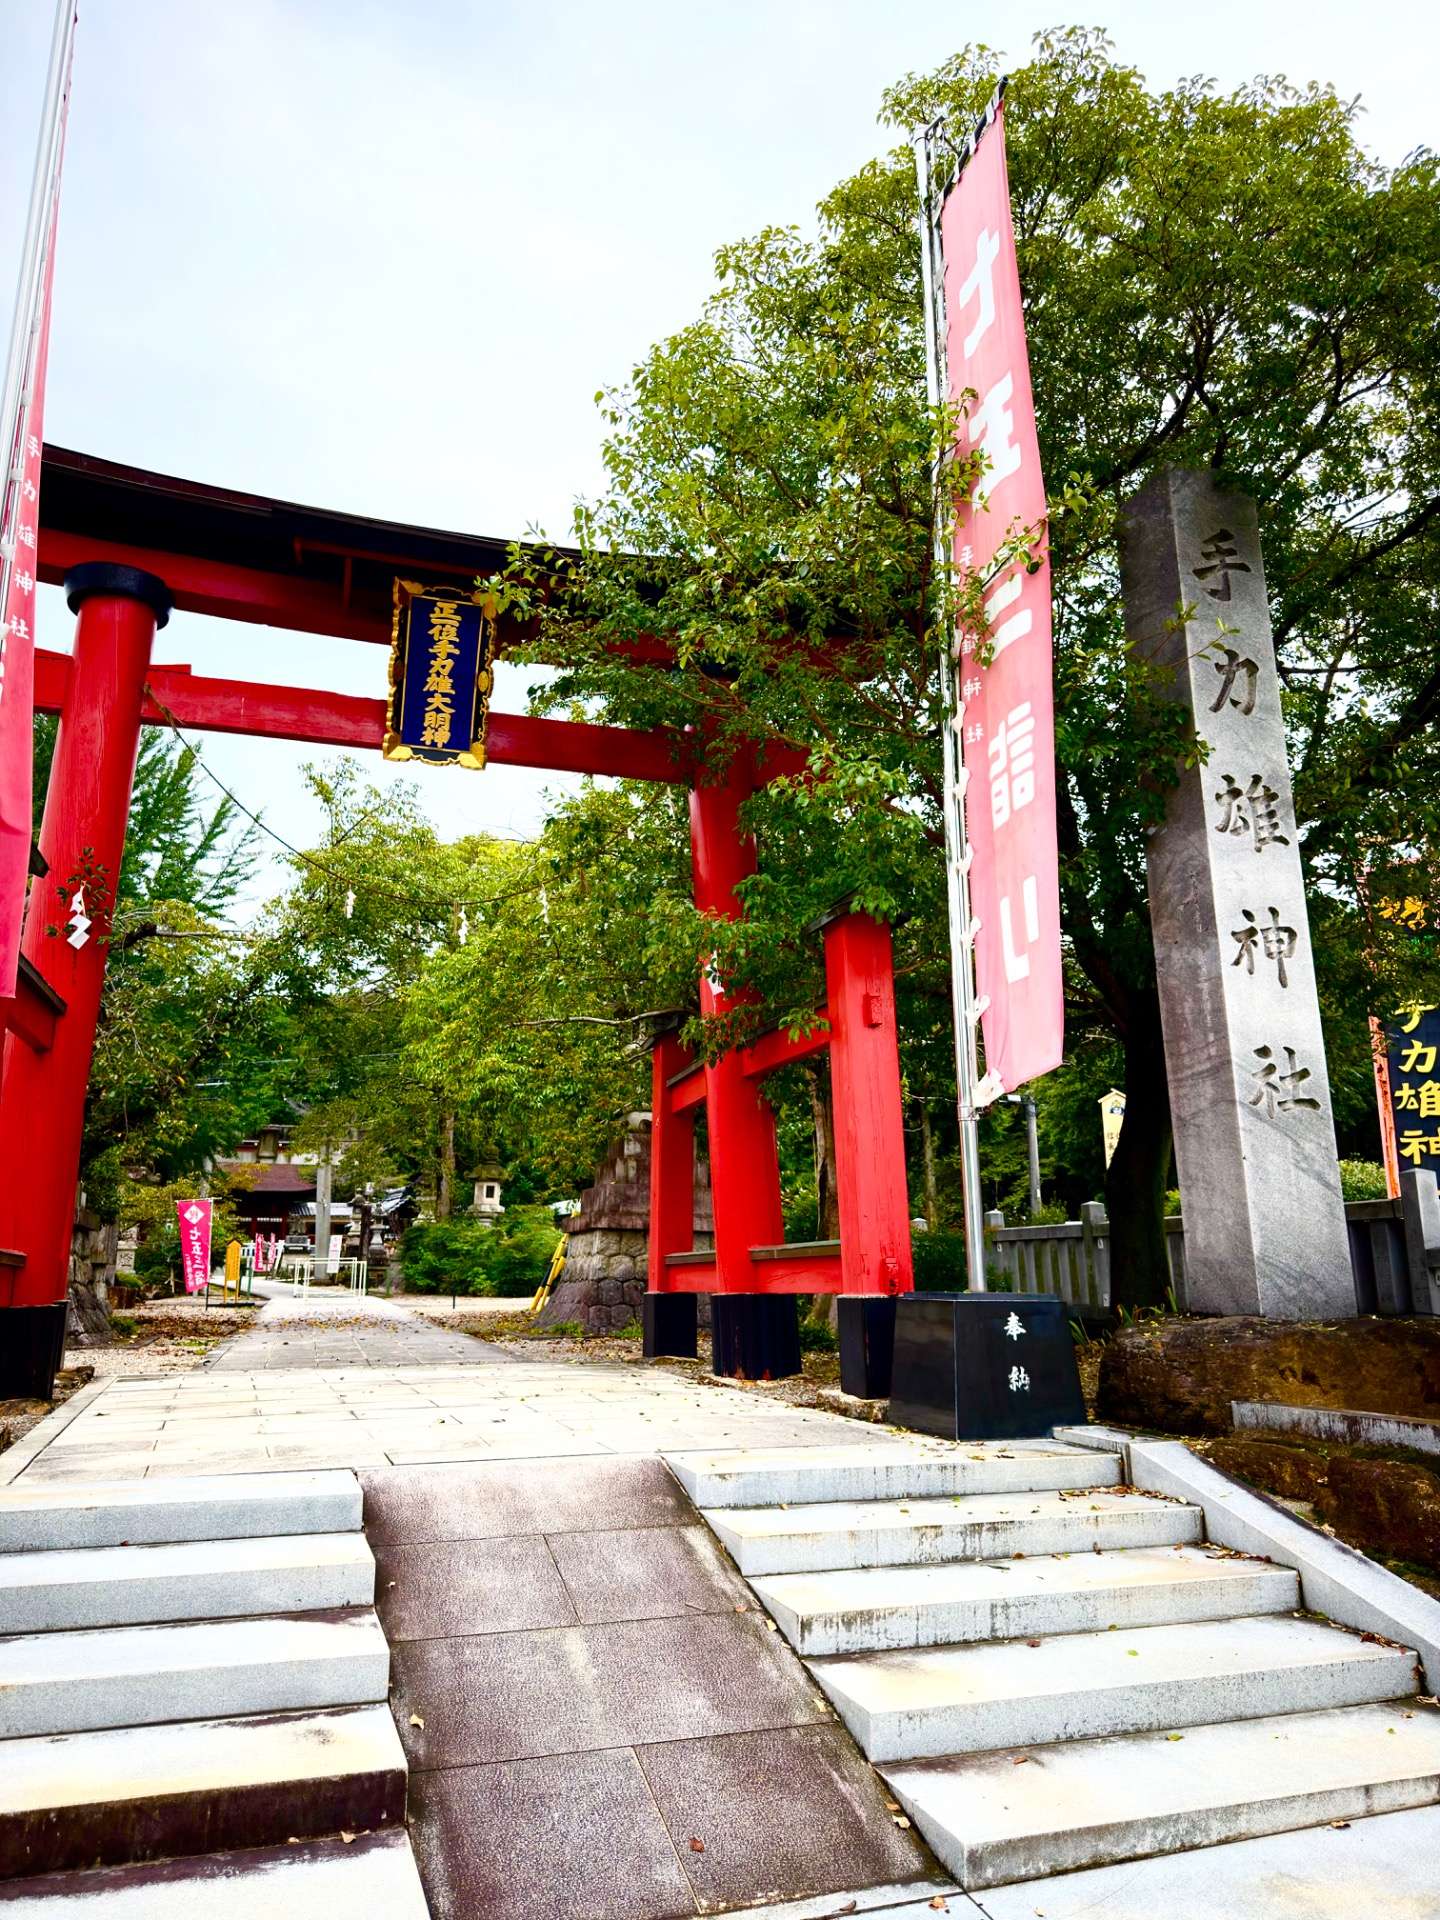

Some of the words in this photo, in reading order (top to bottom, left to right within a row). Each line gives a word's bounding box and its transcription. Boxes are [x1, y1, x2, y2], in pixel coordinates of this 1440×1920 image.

[9, 434, 41, 640] 手力雄神社
[421, 602, 463, 748] 正一位手力雄大明神
[1192, 528, 1321, 1120] 手力雄神社
[1003, 1311, 1031, 1393] 奉納
